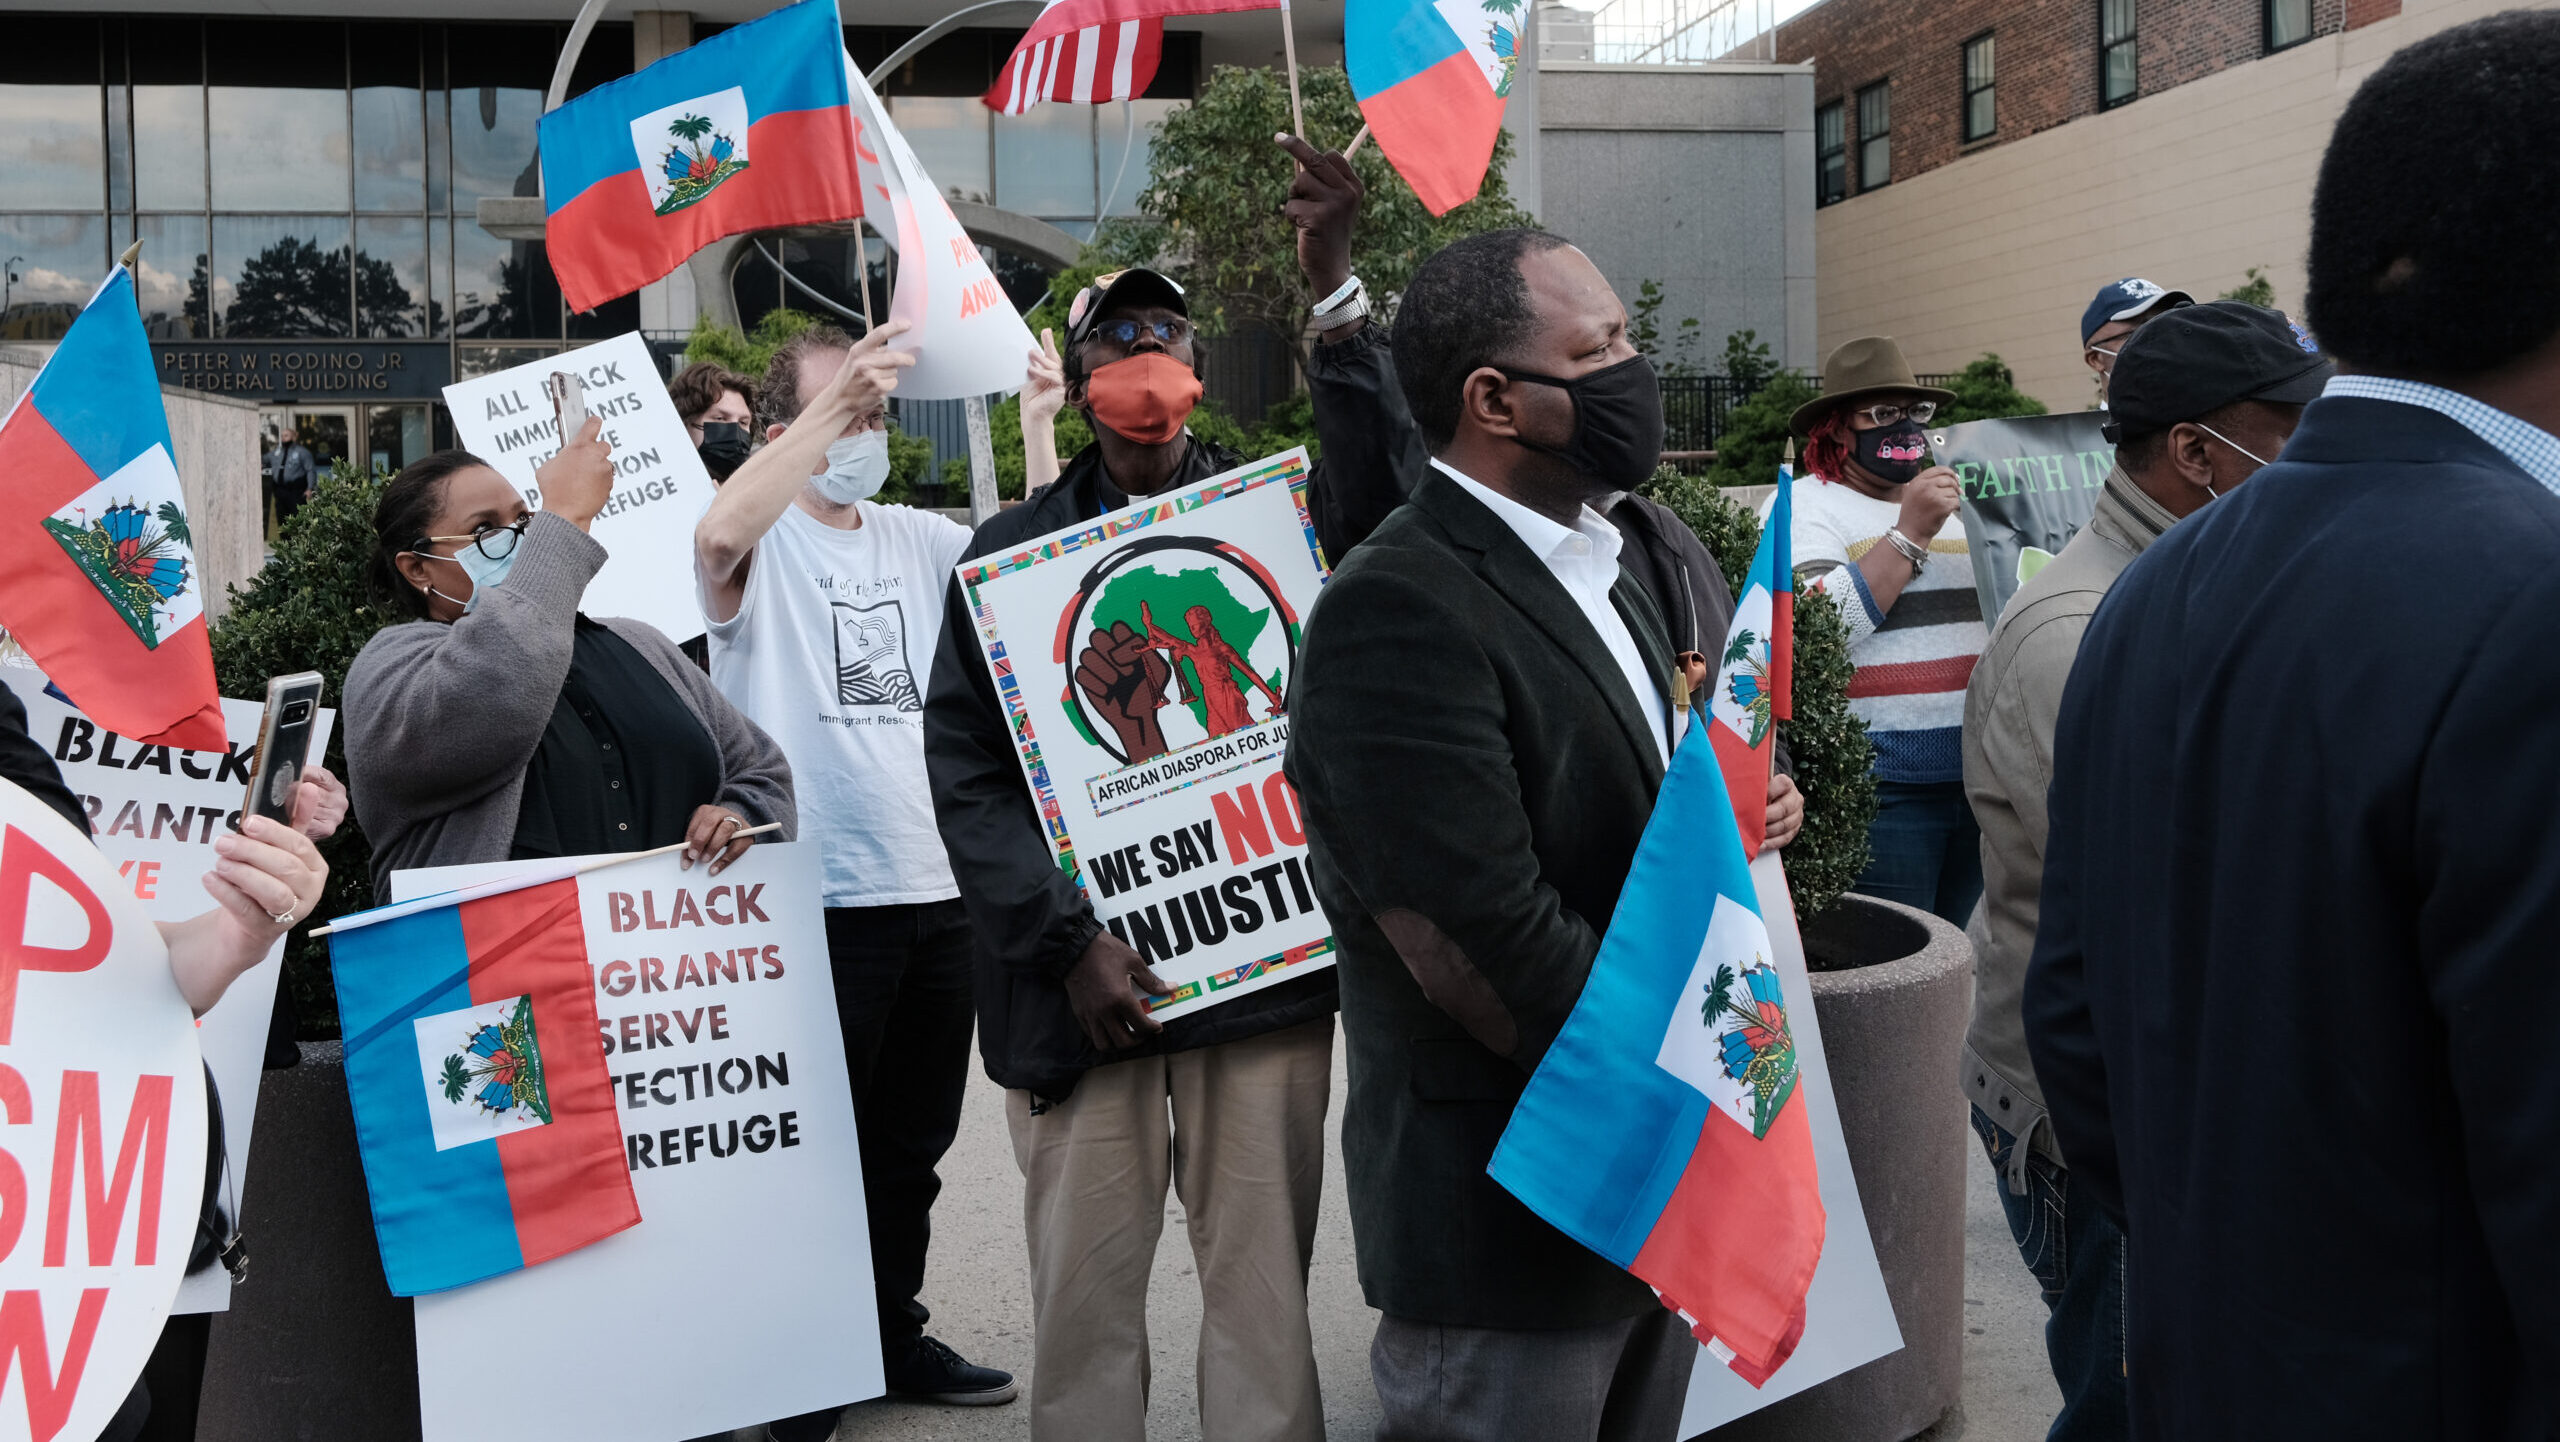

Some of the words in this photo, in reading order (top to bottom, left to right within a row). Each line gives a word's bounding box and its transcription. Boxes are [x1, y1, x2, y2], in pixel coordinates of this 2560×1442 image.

[960, 277, 998, 319] AND
[164, 353, 230, 370] PETER
[240, 353, 258, 370] W
[270, 352, 364, 370] RODINO
[181, 373, 275, 390] FEDERAL
[285, 372, 389, 390] BUILDING
[485, 389, 530, 421] ALL
[541, 361, 627, 402] BACK
[1955, 454, 2071, 501] FAITH
[818, 712, 872, 728] Immigrant
[55, 716, 258, 786] BLACK
[1097, 769, 1161, 802] AFRICAN
[1164, 743, 1237, 780] DIASPORA
[1237, 730, 1270, 754] FOR
[1087, 843, 1152, 899] WE
[1149, 818, 1218, 878] SAY
[1210, 769, 1308, 866] NO
[607, 883, 771, 933] BLACK
[1107, 852, 1320, 966] INJUSTI
[627, 1110, 800, 1171] REFUGE
